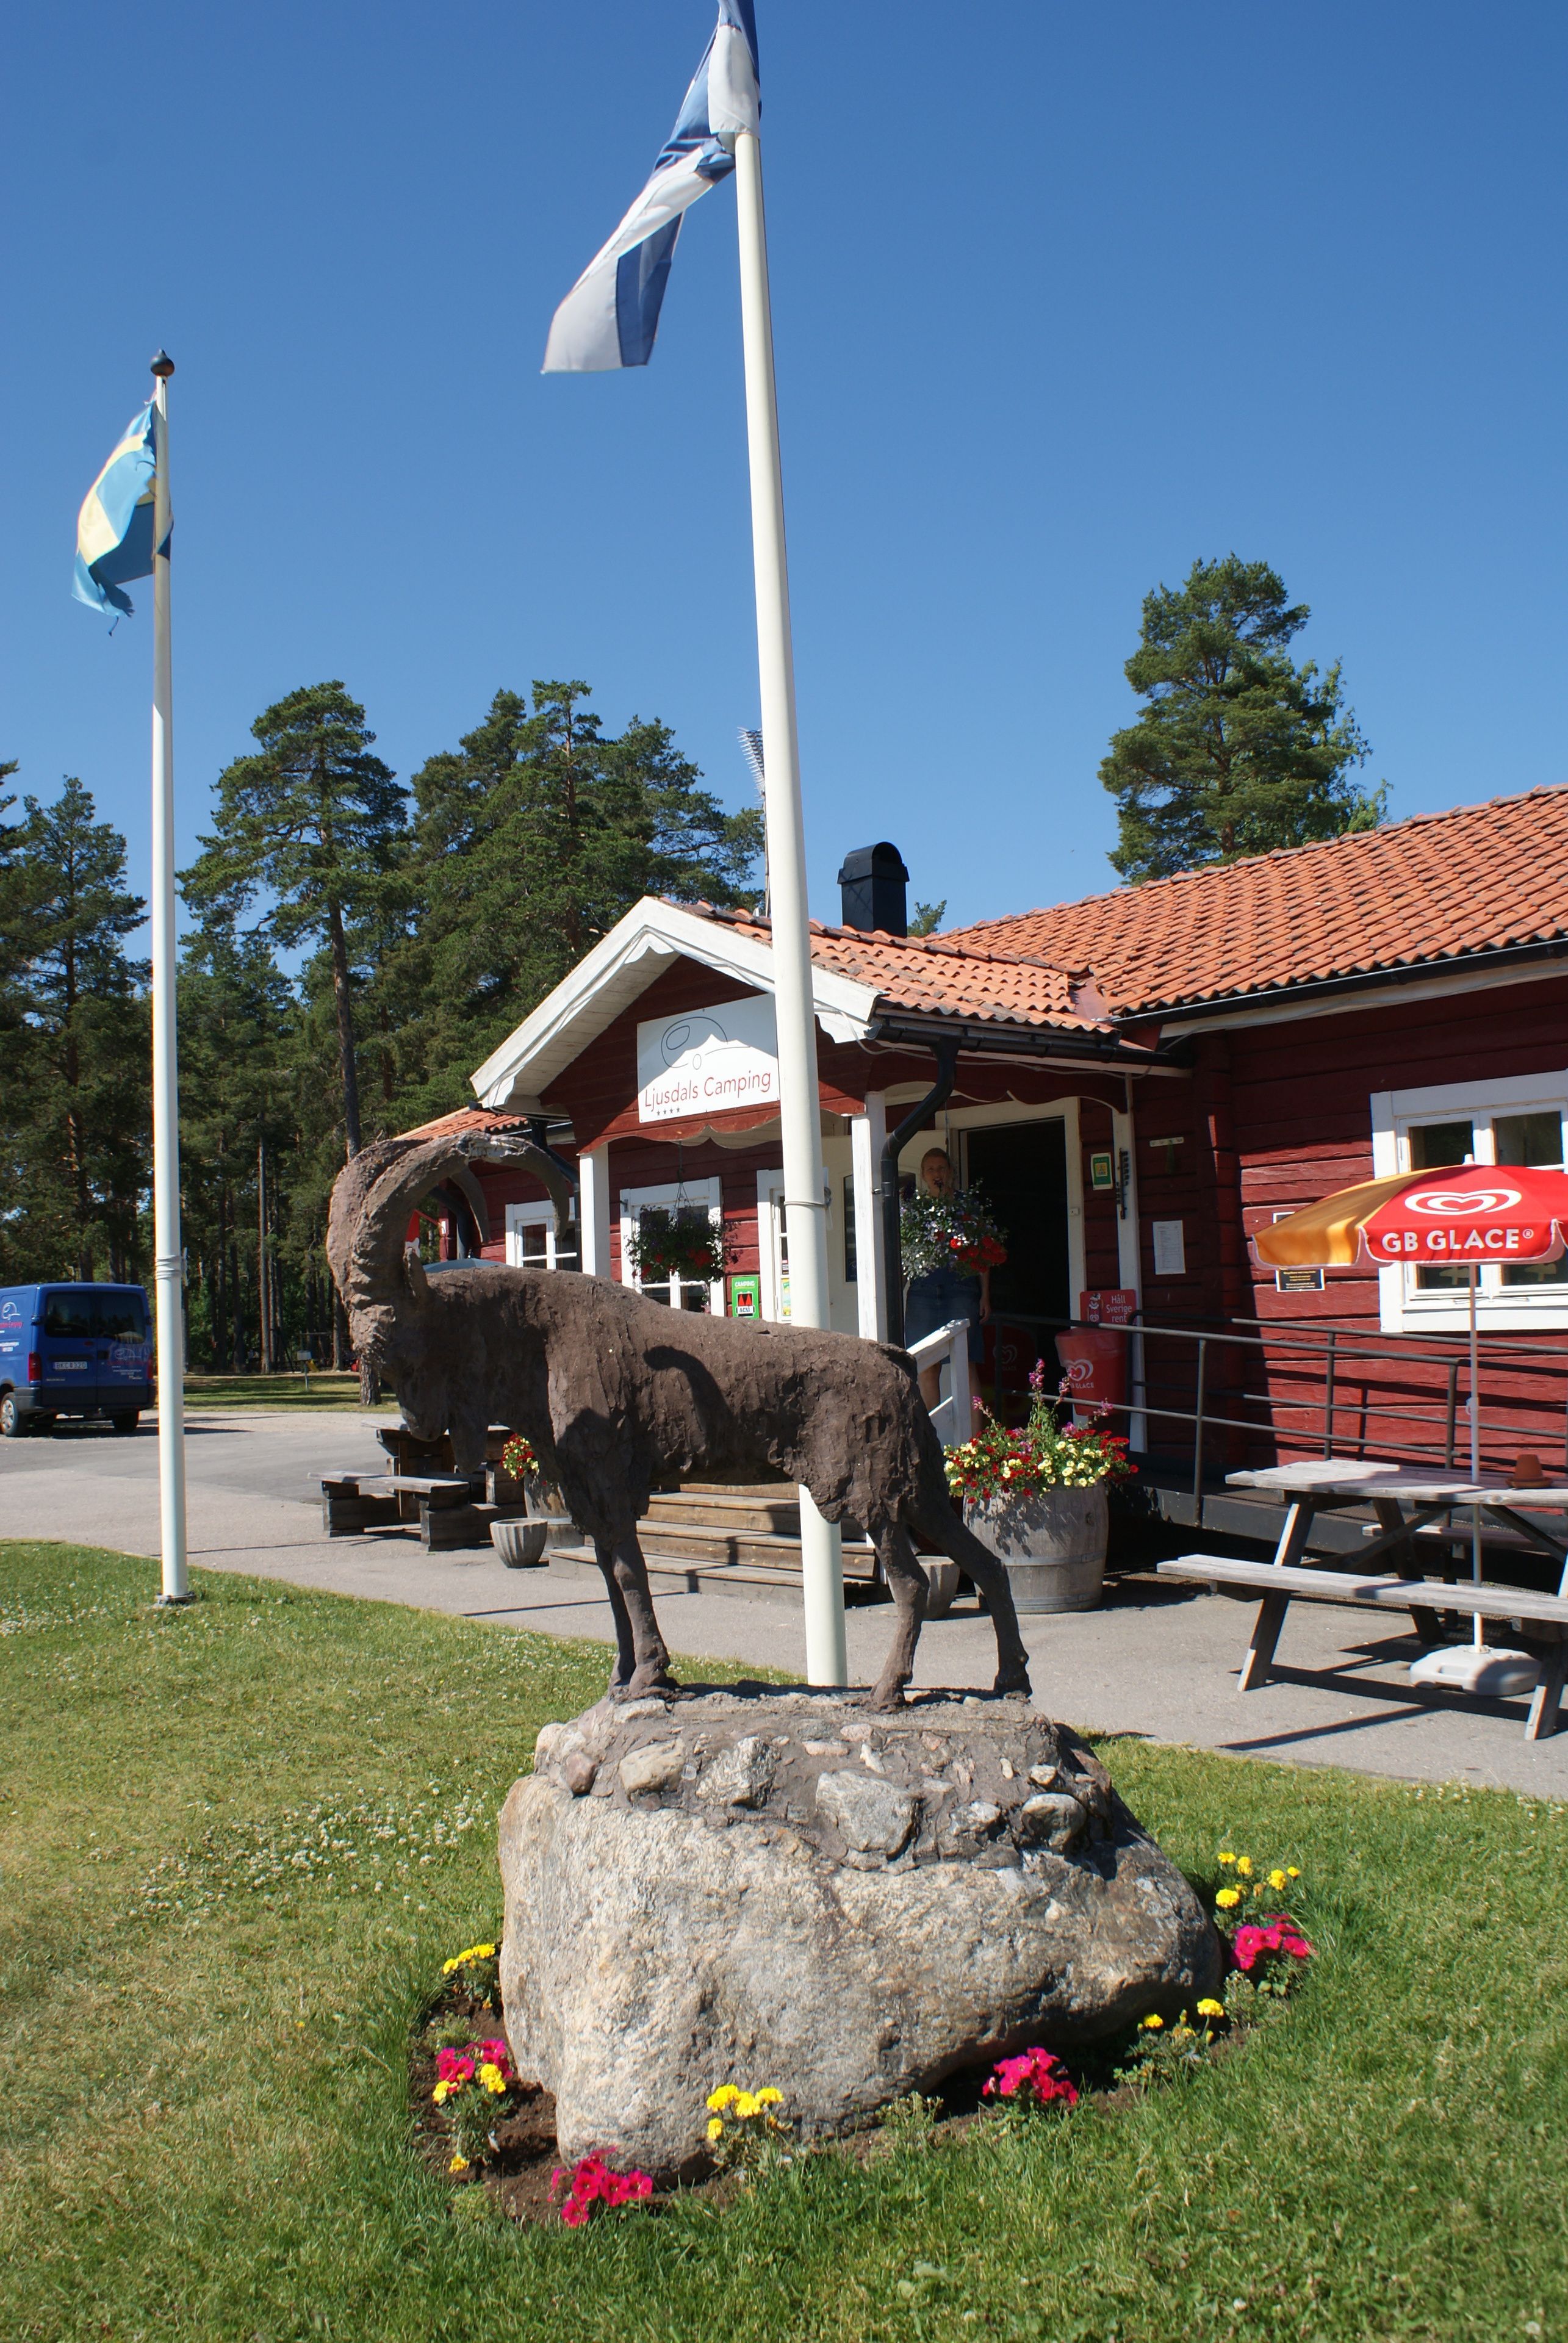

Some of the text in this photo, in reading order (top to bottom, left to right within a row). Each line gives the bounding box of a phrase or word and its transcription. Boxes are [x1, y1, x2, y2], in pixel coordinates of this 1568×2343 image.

[644, 1070, 771, 1112] Ljusdals Camping
[1382, 1231, 1418, 1253] GB
[1111, 1294, 1126, 1304] Håll
[1106, 1304, 1133, 1315] Sverige
[1112, 1314, 1127, 1323] rent
